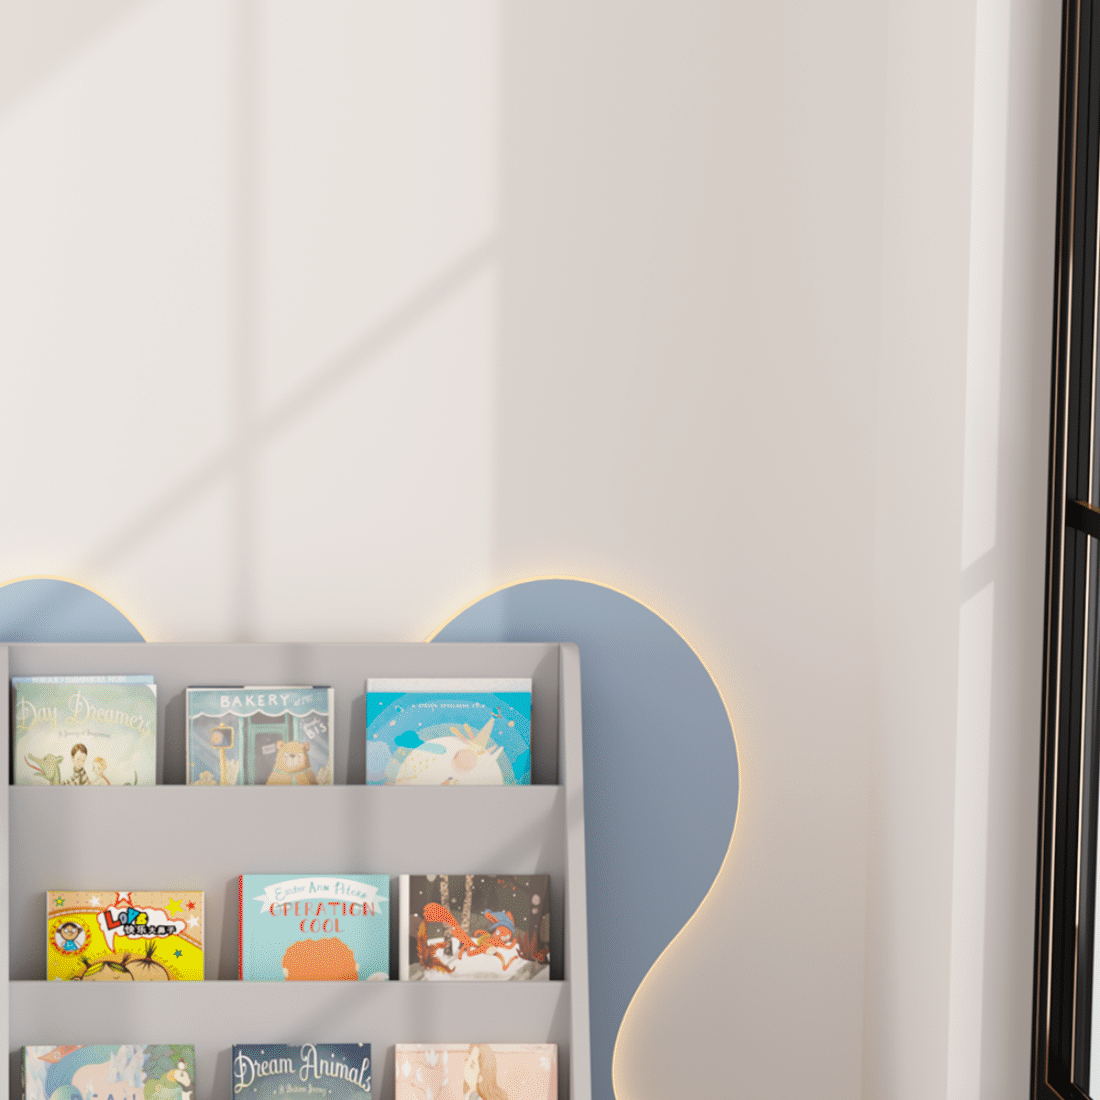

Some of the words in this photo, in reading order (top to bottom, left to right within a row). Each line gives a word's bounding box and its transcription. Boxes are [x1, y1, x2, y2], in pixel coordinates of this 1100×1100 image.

[220, 693, 289, 708] BAKERY
[16, 696, 57, 729] Day
[65, 689, 151, 736] Dreamers
[269, 901, 375, 917] OPERATION
[300, 918, 345, 934] COOL
[233, 1050, 297, 1094] Dream
[300, 1043, 372, 1092] Animals
